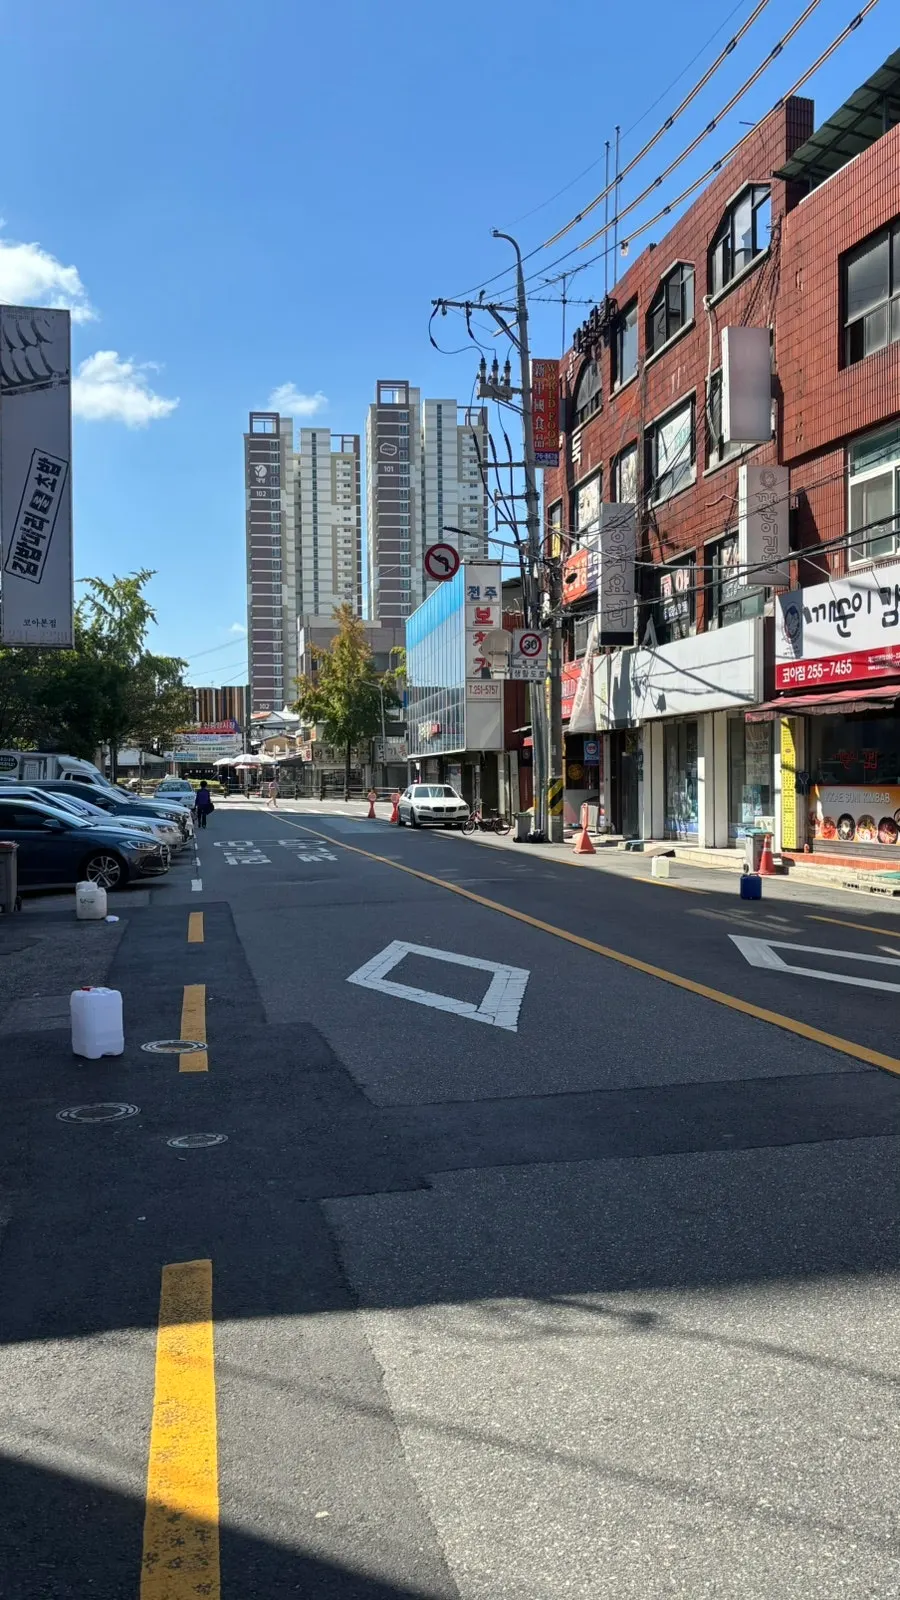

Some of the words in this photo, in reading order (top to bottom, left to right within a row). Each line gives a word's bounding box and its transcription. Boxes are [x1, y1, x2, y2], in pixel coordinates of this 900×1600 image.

[546, 412, 557, 448] FOOD
[467, 585, 498, 601] 전주
[879, 583, 900, 629] 김
[523, 639, 538, 651] 30
[781, 664, 807, 684] 코아점
[807, 658, 853, 680] 255-7455
